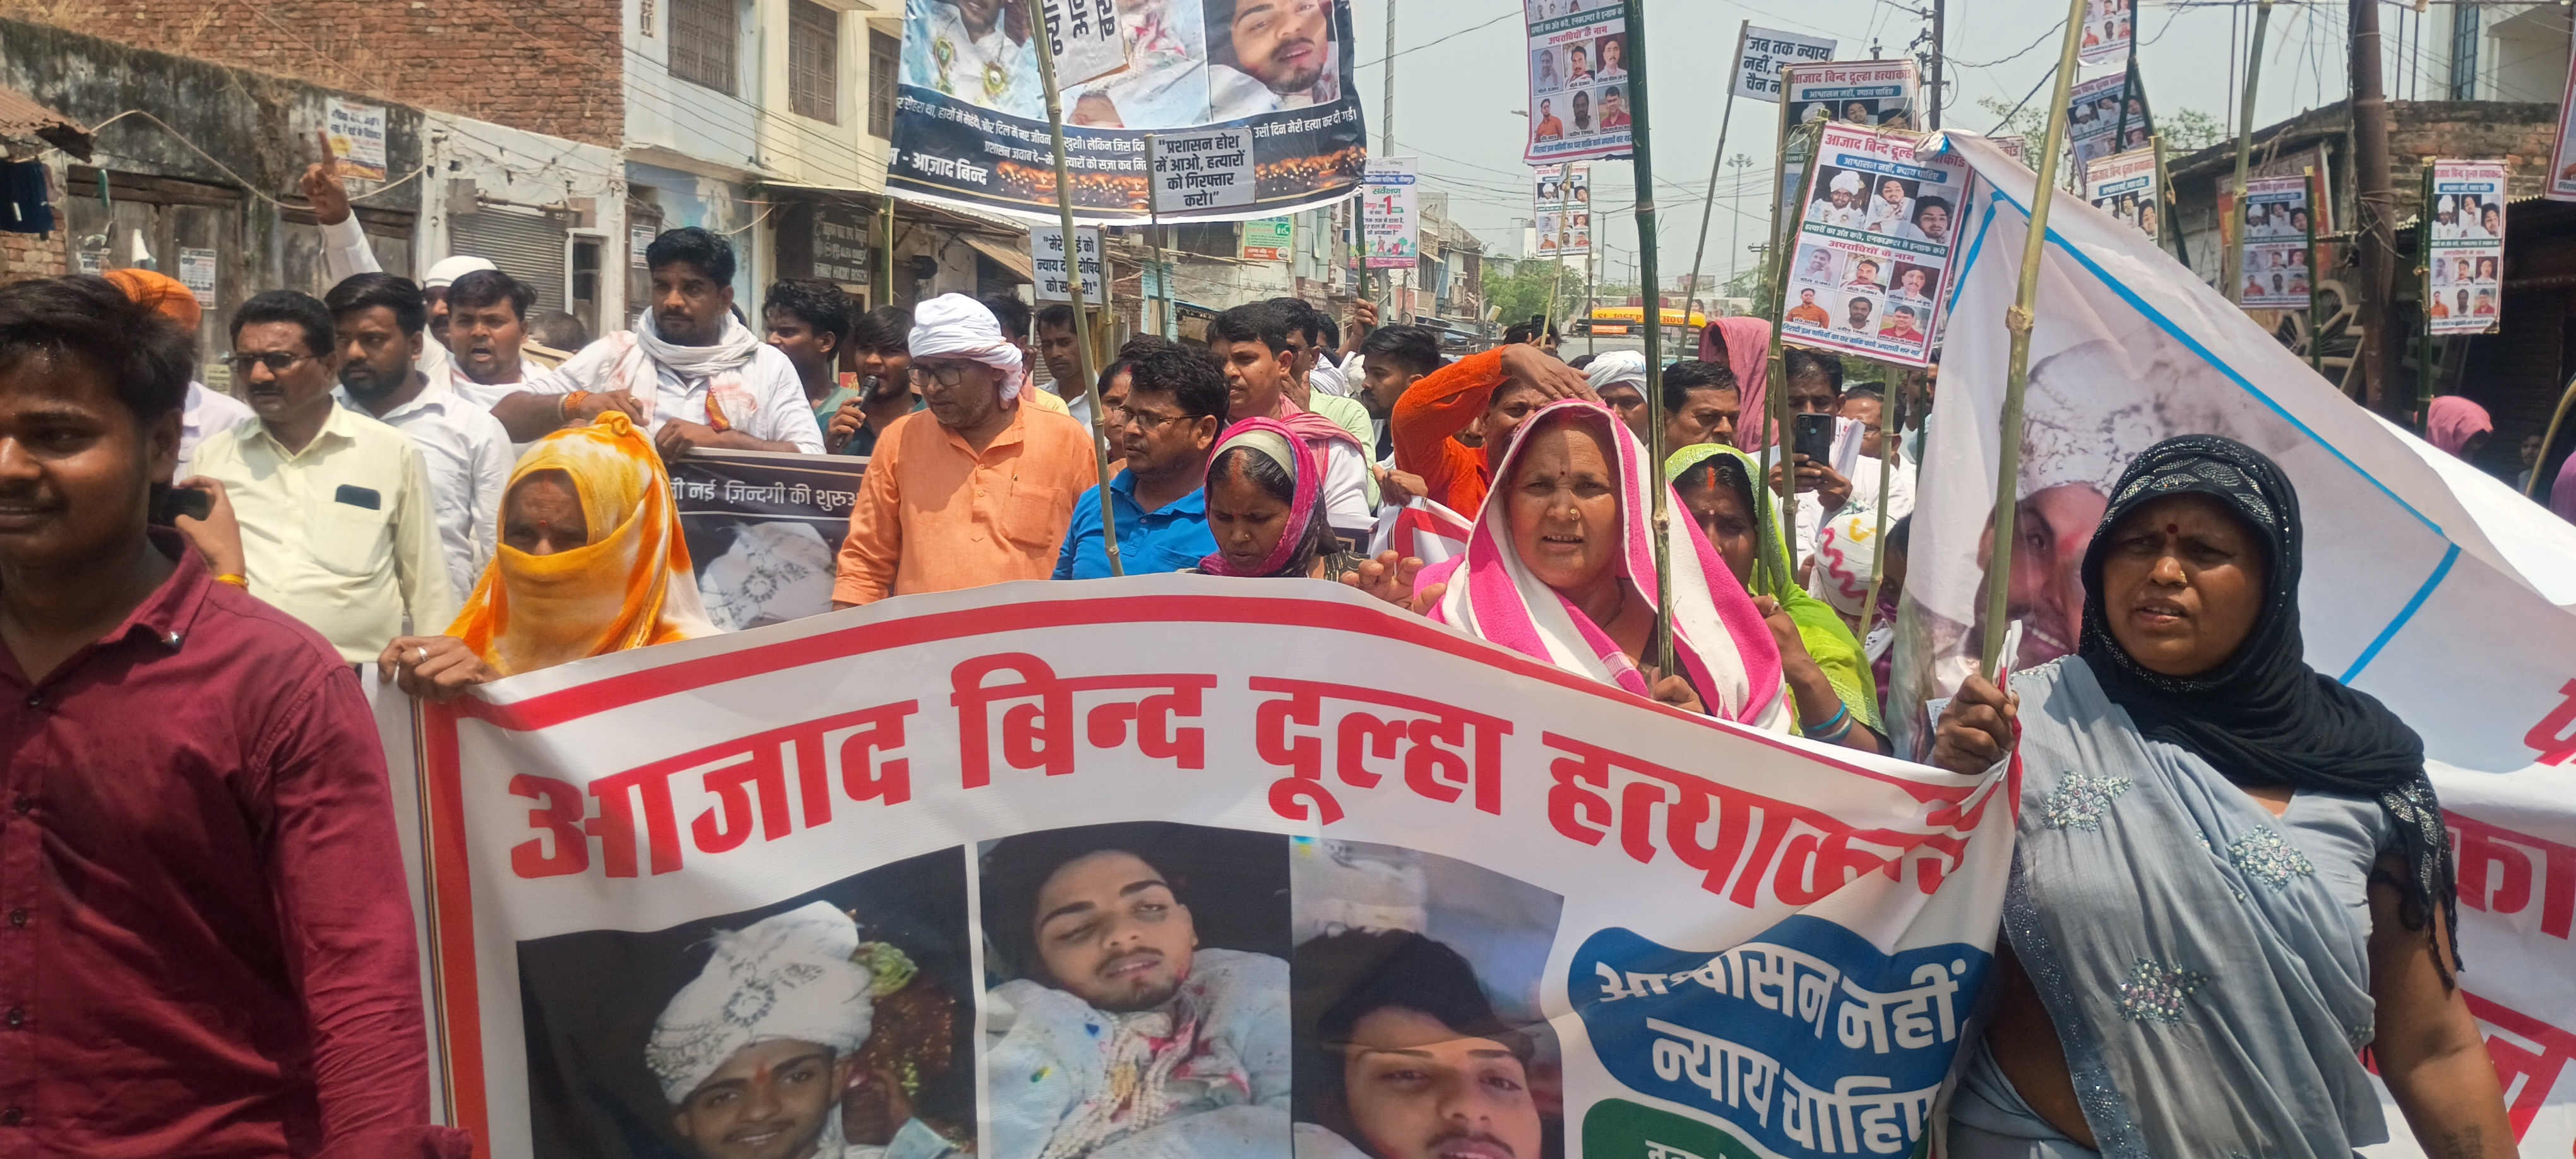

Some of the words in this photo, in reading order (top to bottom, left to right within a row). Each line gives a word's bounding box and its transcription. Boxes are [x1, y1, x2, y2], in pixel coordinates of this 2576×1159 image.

[1772, 40, 1796, 56] तक
[1744, 54, 1772, 75] नहीं,
[1746, 72, 1768, 92] चैन
[1825, 69, 1846, 83] बिन्द
[1849, 71, 1871, 85] दूल्हा
[925, 103, 937, 119] था,
[938, 106, 957, 121] हाथों
[996, 120, 1011, 138] दिल
[1018, 128, 1030, 142] नए
[1030, 128, 1052, 146] जीवन
[1087, 136, 1112, 151] लेकिन
[1113, 137, 1131, 153] जिस
[1254, 124, 1270, 139] उसी
[1270, 121, 1286, 137] दिन
[1287, 117, 1304, 134] मेरी
[1304, 117, 1321, 132] हत्या
[1159, 134, 1212, 154] "प्रशासन
[1216, 132, 1239, 150] होश
[1825, 133, 1863, 151] आजाद
[1864, 138, 1888, 154] बिन्द
[1891, 144, 1914, 165] दूल्ह
[984, 140, 1011, 158] प्रशासन
[1011, 147, 1032, 163] जवाब
[1065, 155, 1086, 169] त्यारों
[1086, 156, 1097, 170] को
[1118, 160, 1132, 172] कब
[1154, 155, 1167, 173] में
[1170, 153, 1204, 172] आओ,
[1207, 150, 1246, 168] हत्यारों
[912, 152, 955, 177] आज़ाद
[957, 158, 988, 186] बिन्द
[1167, 172, 1183, 191] को
[1083, 236, 1095, 253] को
[1036, 258, 1059, 272] न्याय
[1045, 276, 1058, 292] को
[1613, 313, 1643, 325] JOSEP
[688, 479, 717, 501] नई
[724, 479, 787, 504] ज़िन्दगी
[790, 484, 812, 505] की
[508, 698, 919, 879] आजाद
[950, 651, 1219, 789] बिन्द
[1248, 675, 1514, 826] दूल्हा
[1646, 1016, 1780, 1129] न्याय
[1782, 1074, 1943, 1154] चाहिए
